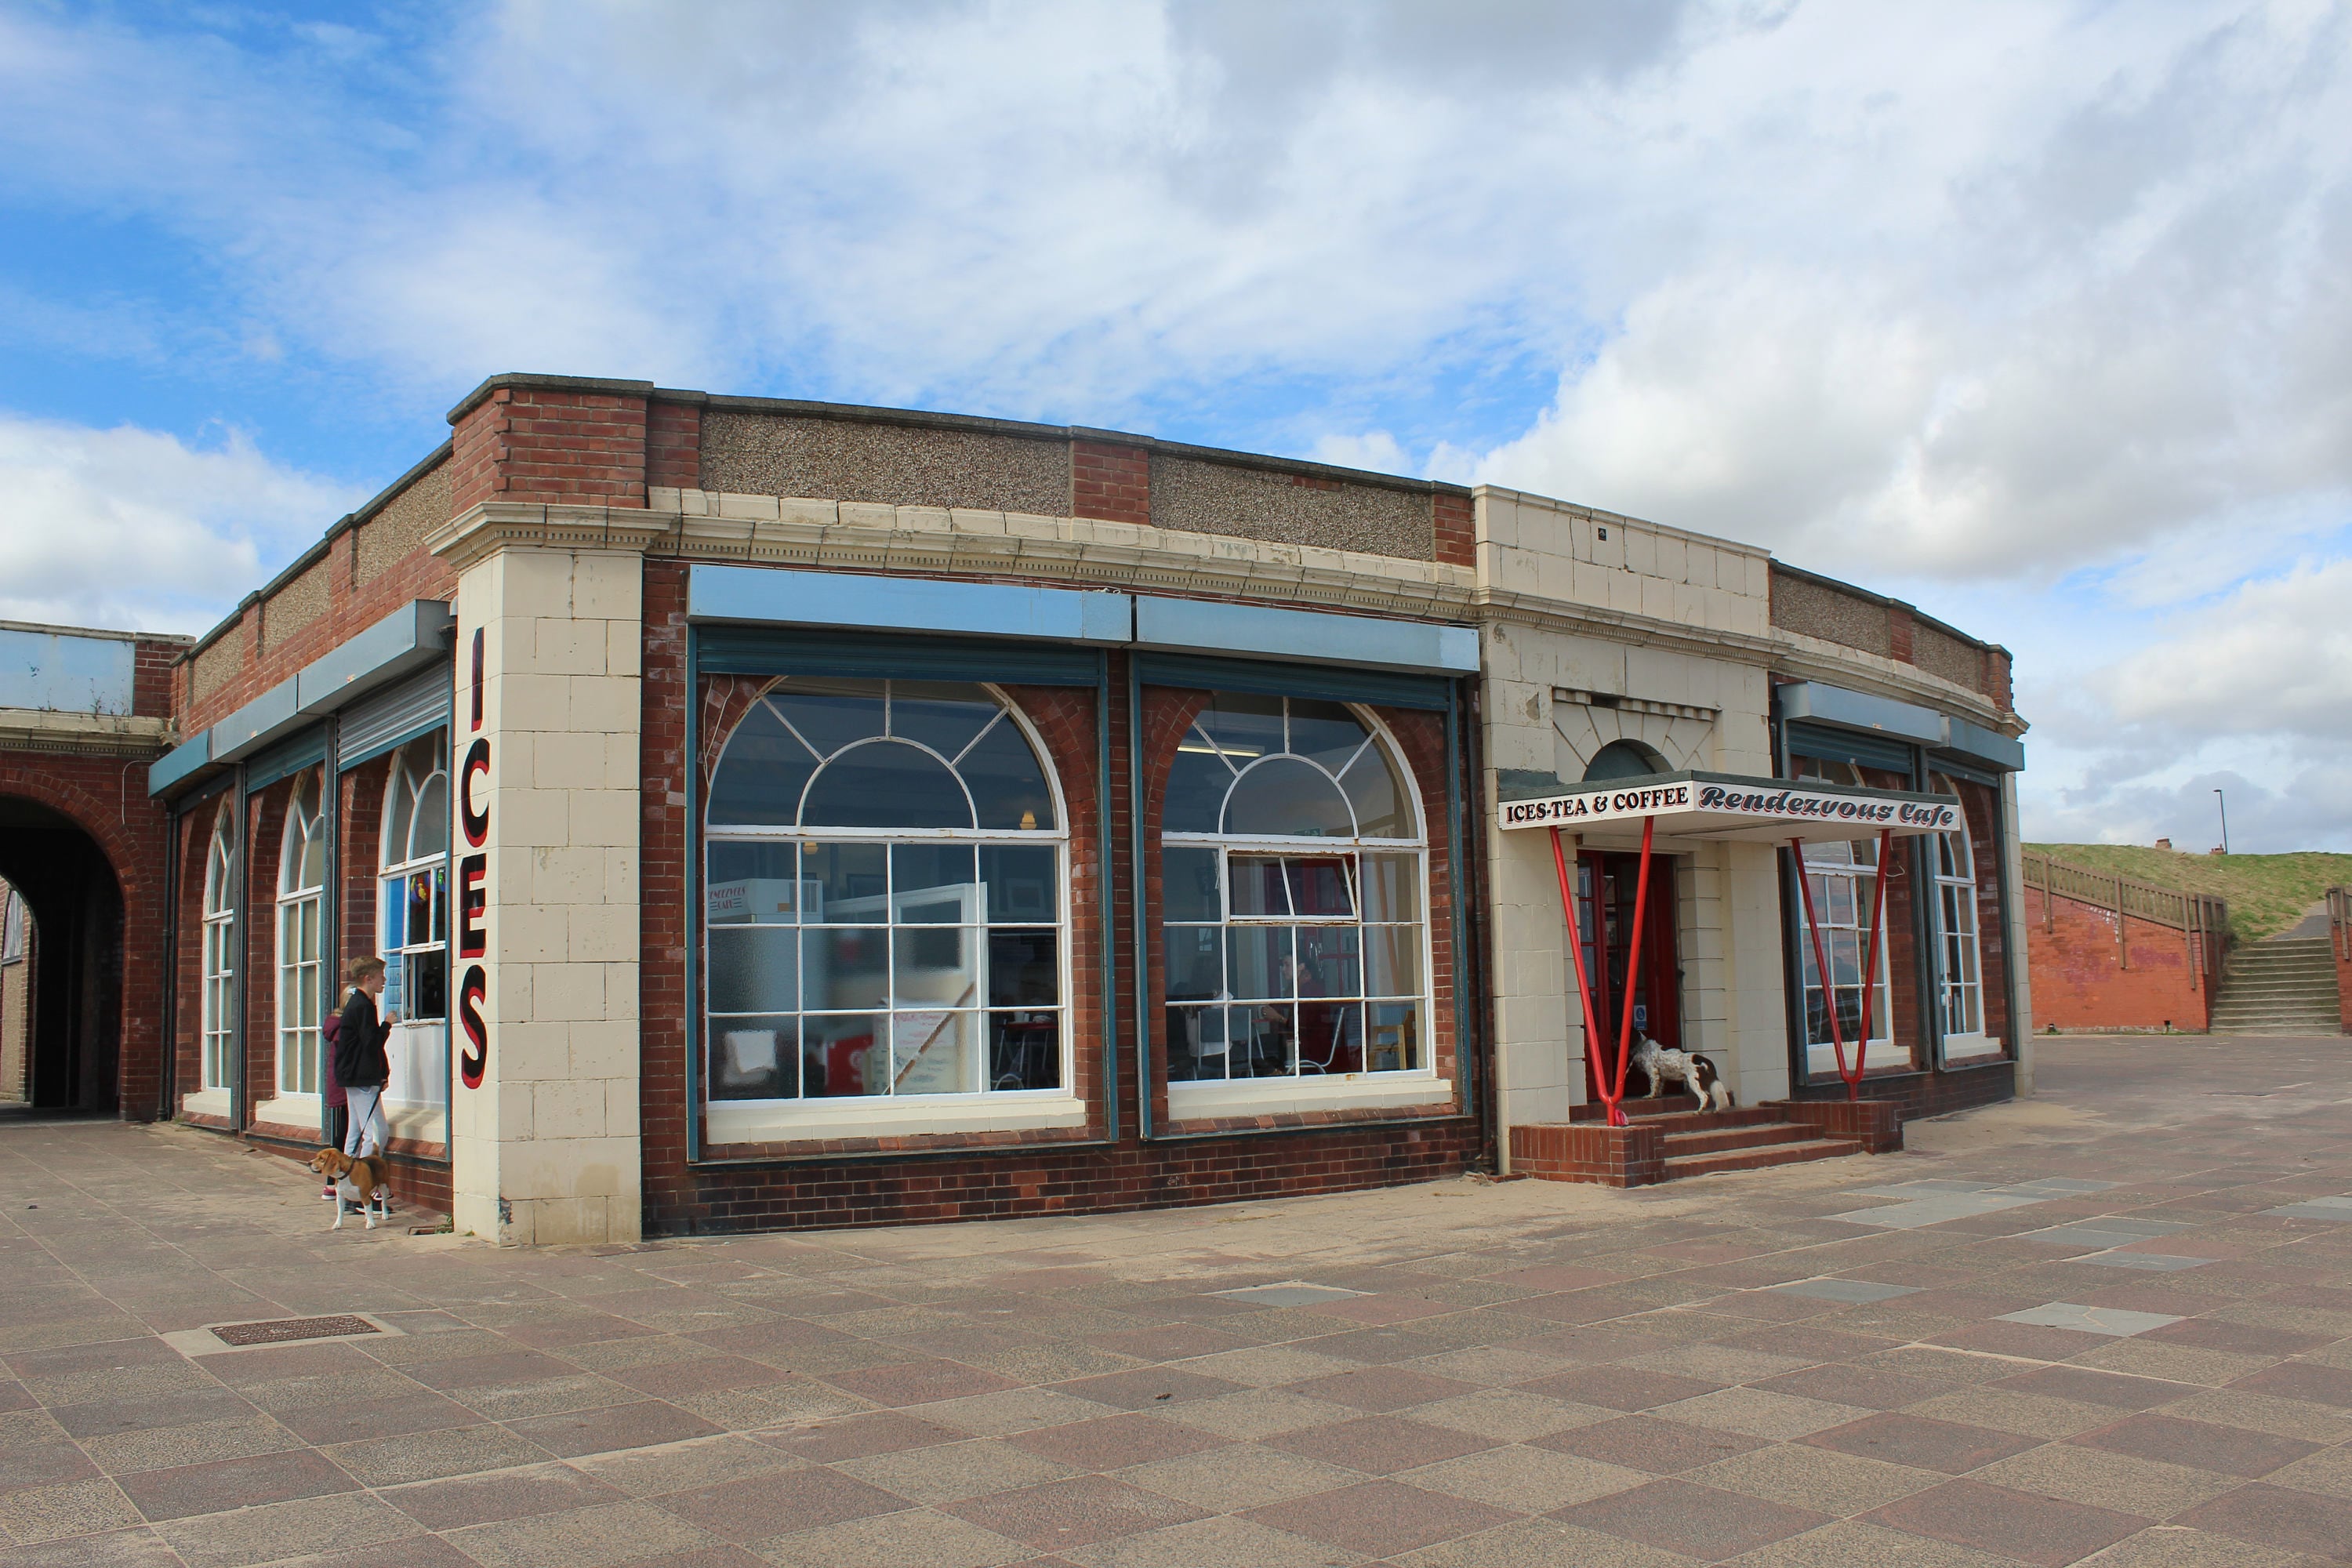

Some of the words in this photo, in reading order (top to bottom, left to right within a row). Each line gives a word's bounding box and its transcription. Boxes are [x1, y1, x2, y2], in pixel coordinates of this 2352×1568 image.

[1592, 796, 1608, 813] &
[1612, 786, 1689, 811] COFFEE
[1698, 786, 1894, 822] Rendezvous
[1898, 802, 1955, 828] Cafe
[459, 627, 490, 1089] ICES
[709, 886, 746, 900] ENDEZVOUS
